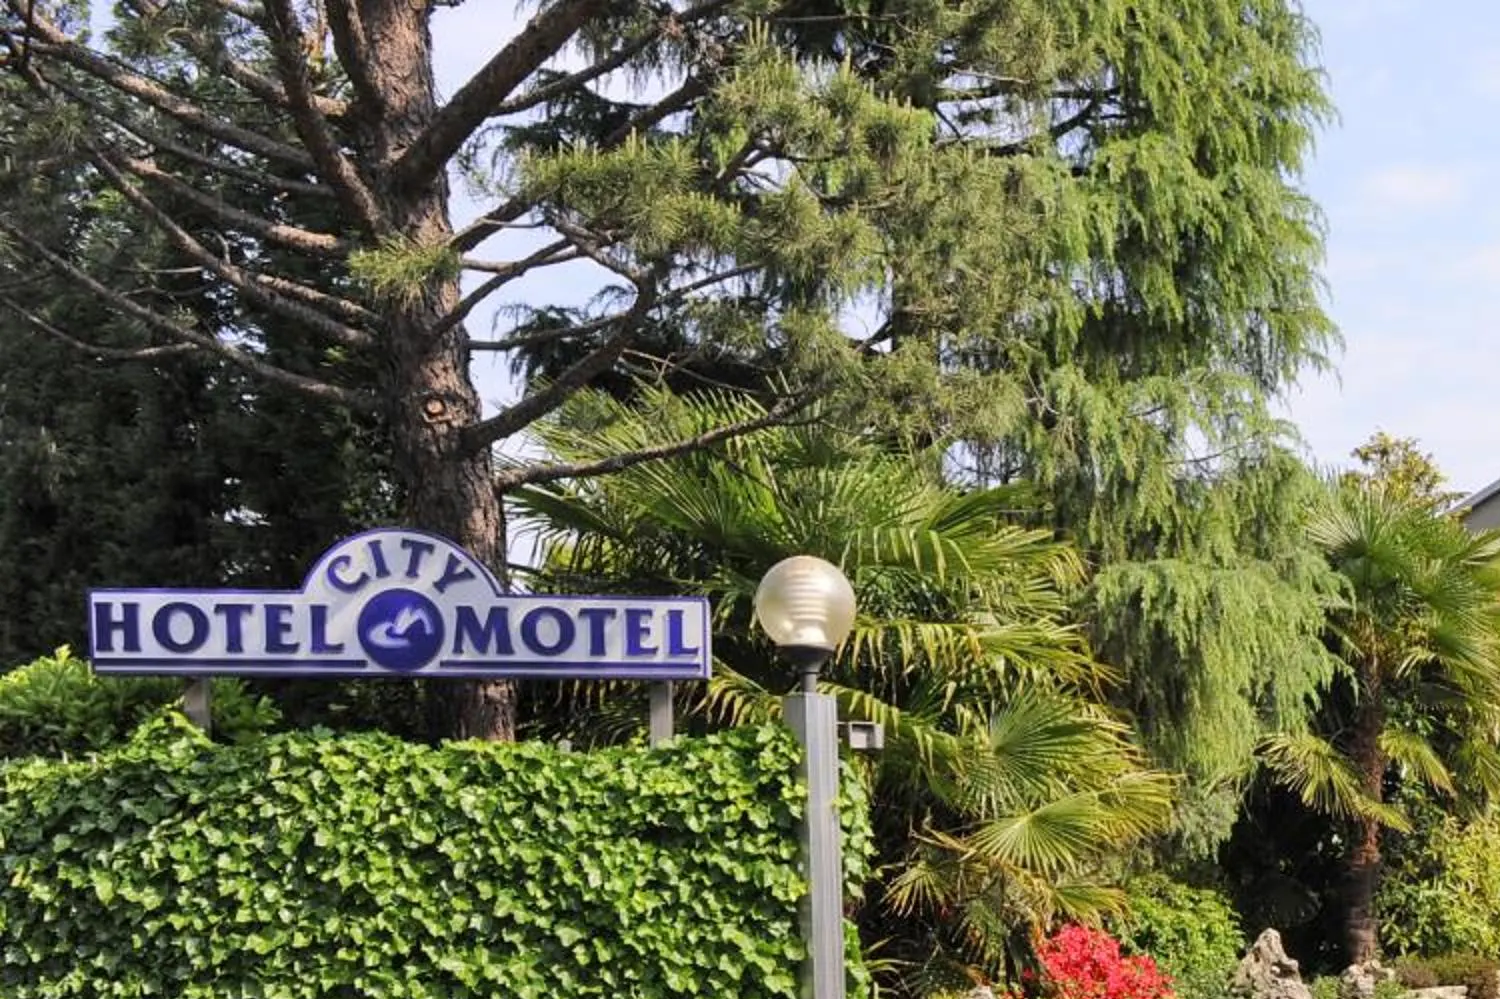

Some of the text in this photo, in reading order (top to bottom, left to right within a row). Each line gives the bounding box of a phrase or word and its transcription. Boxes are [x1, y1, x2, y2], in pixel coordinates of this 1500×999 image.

[325, 538, 478, 594] CITY
[94, 601, 345, 654] HOTEL
[453, 605, 701, 658] MOTEL
